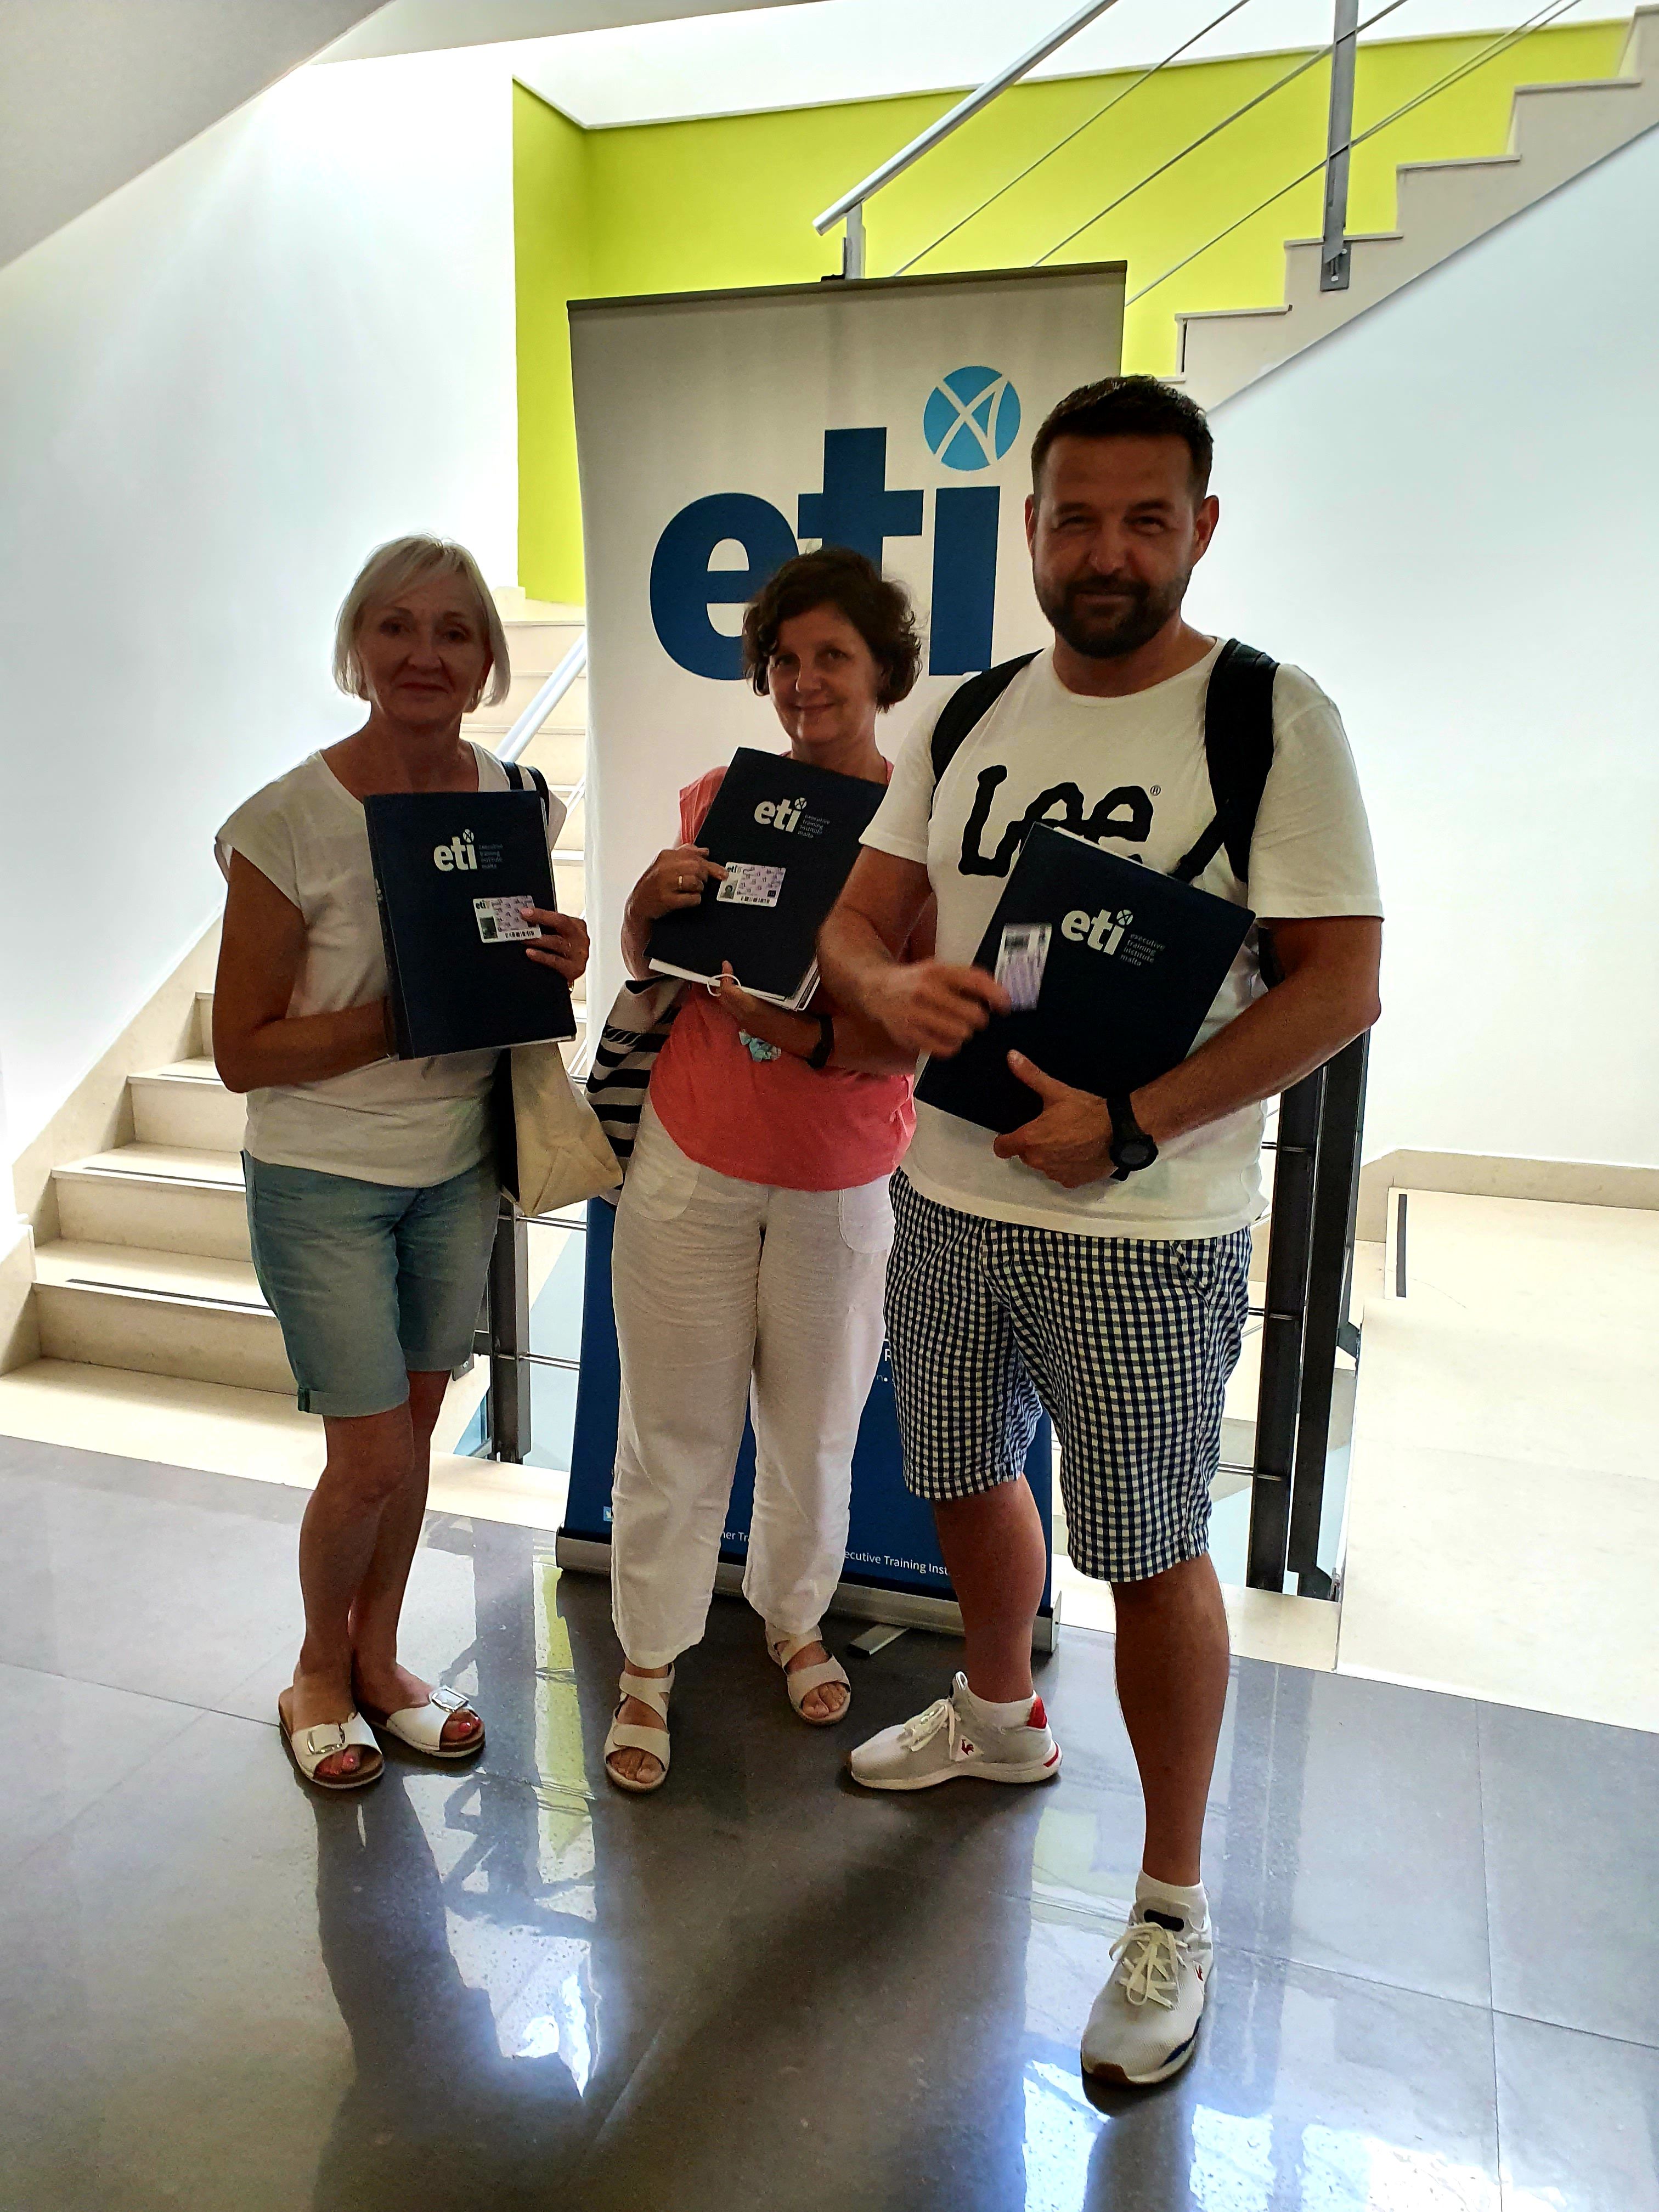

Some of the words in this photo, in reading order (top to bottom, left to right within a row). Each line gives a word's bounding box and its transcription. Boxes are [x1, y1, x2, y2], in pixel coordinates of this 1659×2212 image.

[650, 365, 1021, 681] eti
[754, 797, 807, 833] eti
[433, 829, 477, 871] eti
[1061, 909, 1133, 955] eti
[1127, 939, 1156, 956] training
[1130, 934, 1166, 951] executive
[1120, 954, 1142, 966] malta
[1124, 946, 1154, 963] institute
[738, 1531, 748, 1542] Tr
[845, 1551, 881, 1564] ecutive
[884, 1555, 926, 1574] Training
[929, 1562, 949, 1576] Inst
